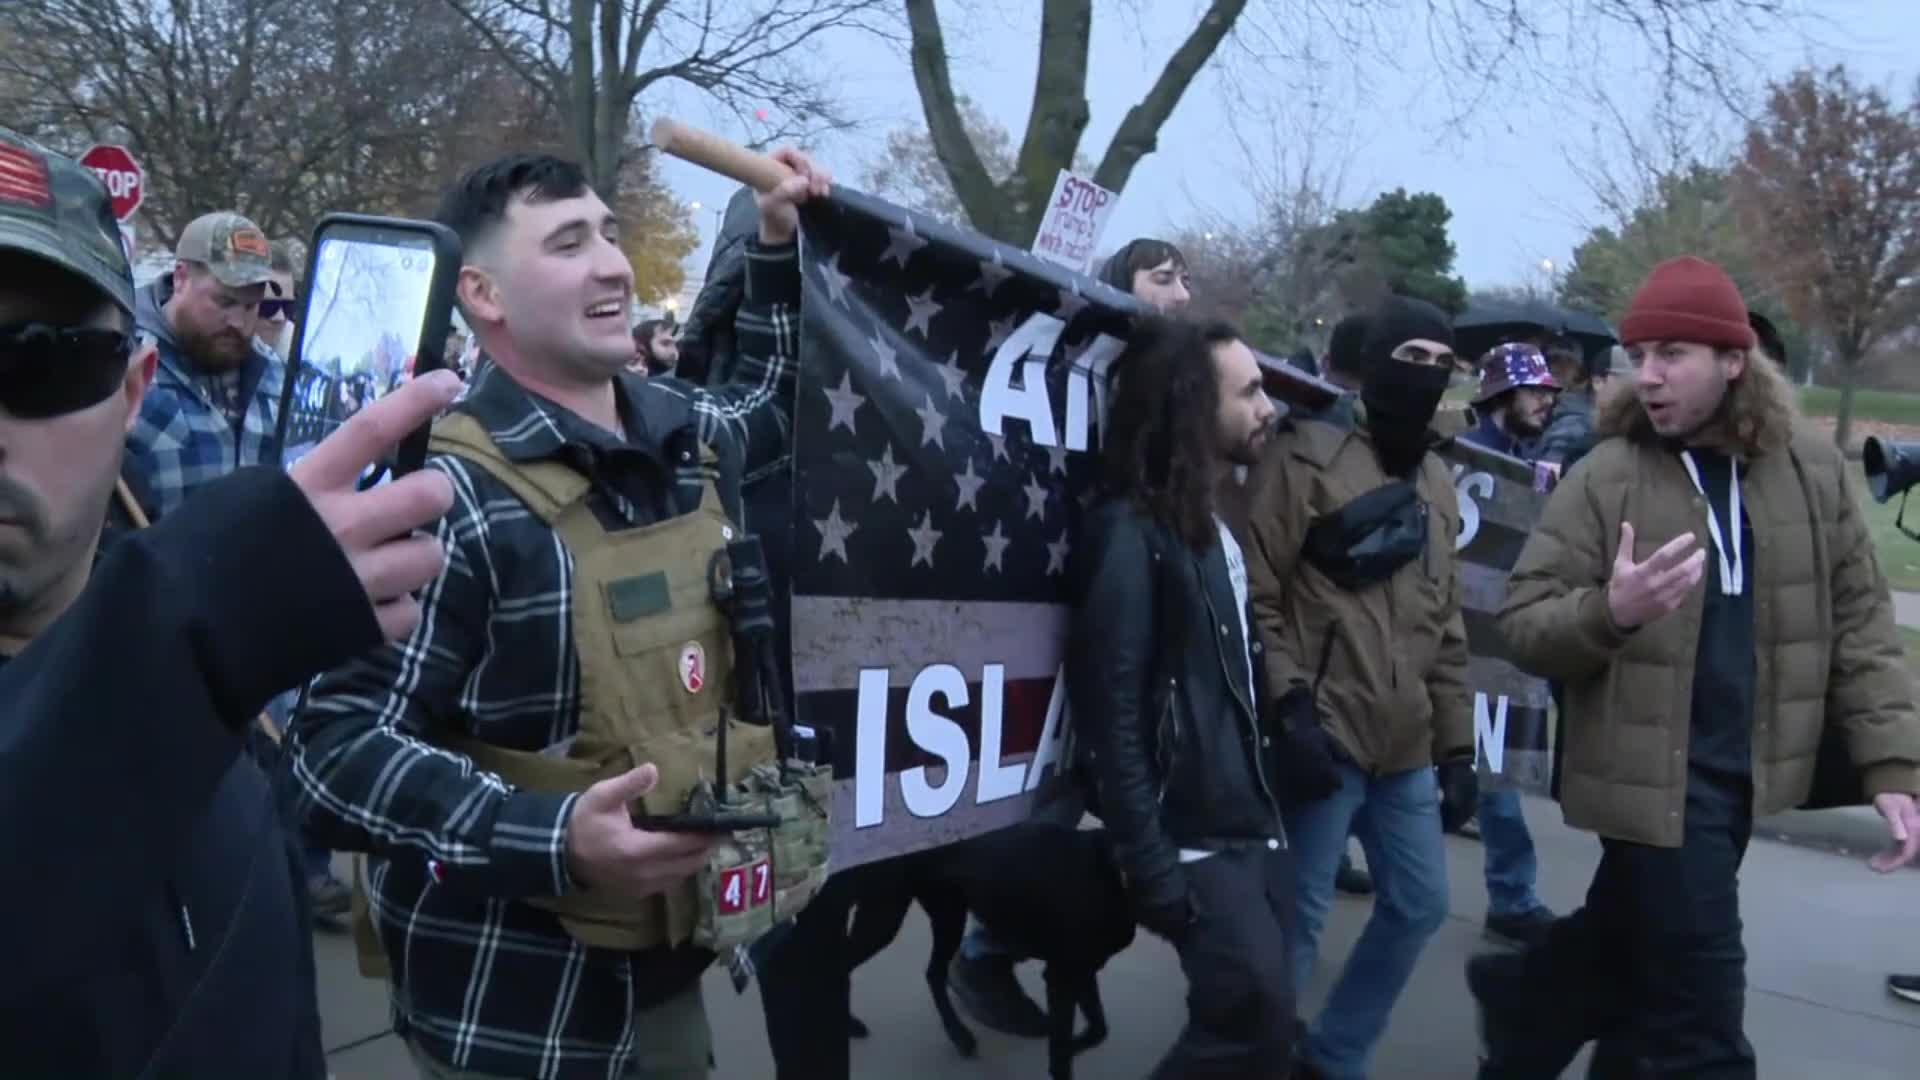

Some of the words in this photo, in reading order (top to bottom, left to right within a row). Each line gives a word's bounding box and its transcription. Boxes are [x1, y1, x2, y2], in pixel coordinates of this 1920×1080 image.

[91, 167, 138, 199] TOP
[1056, 176, 1108, 216] STOP
[856, 661, 1076, 828] ISLA
